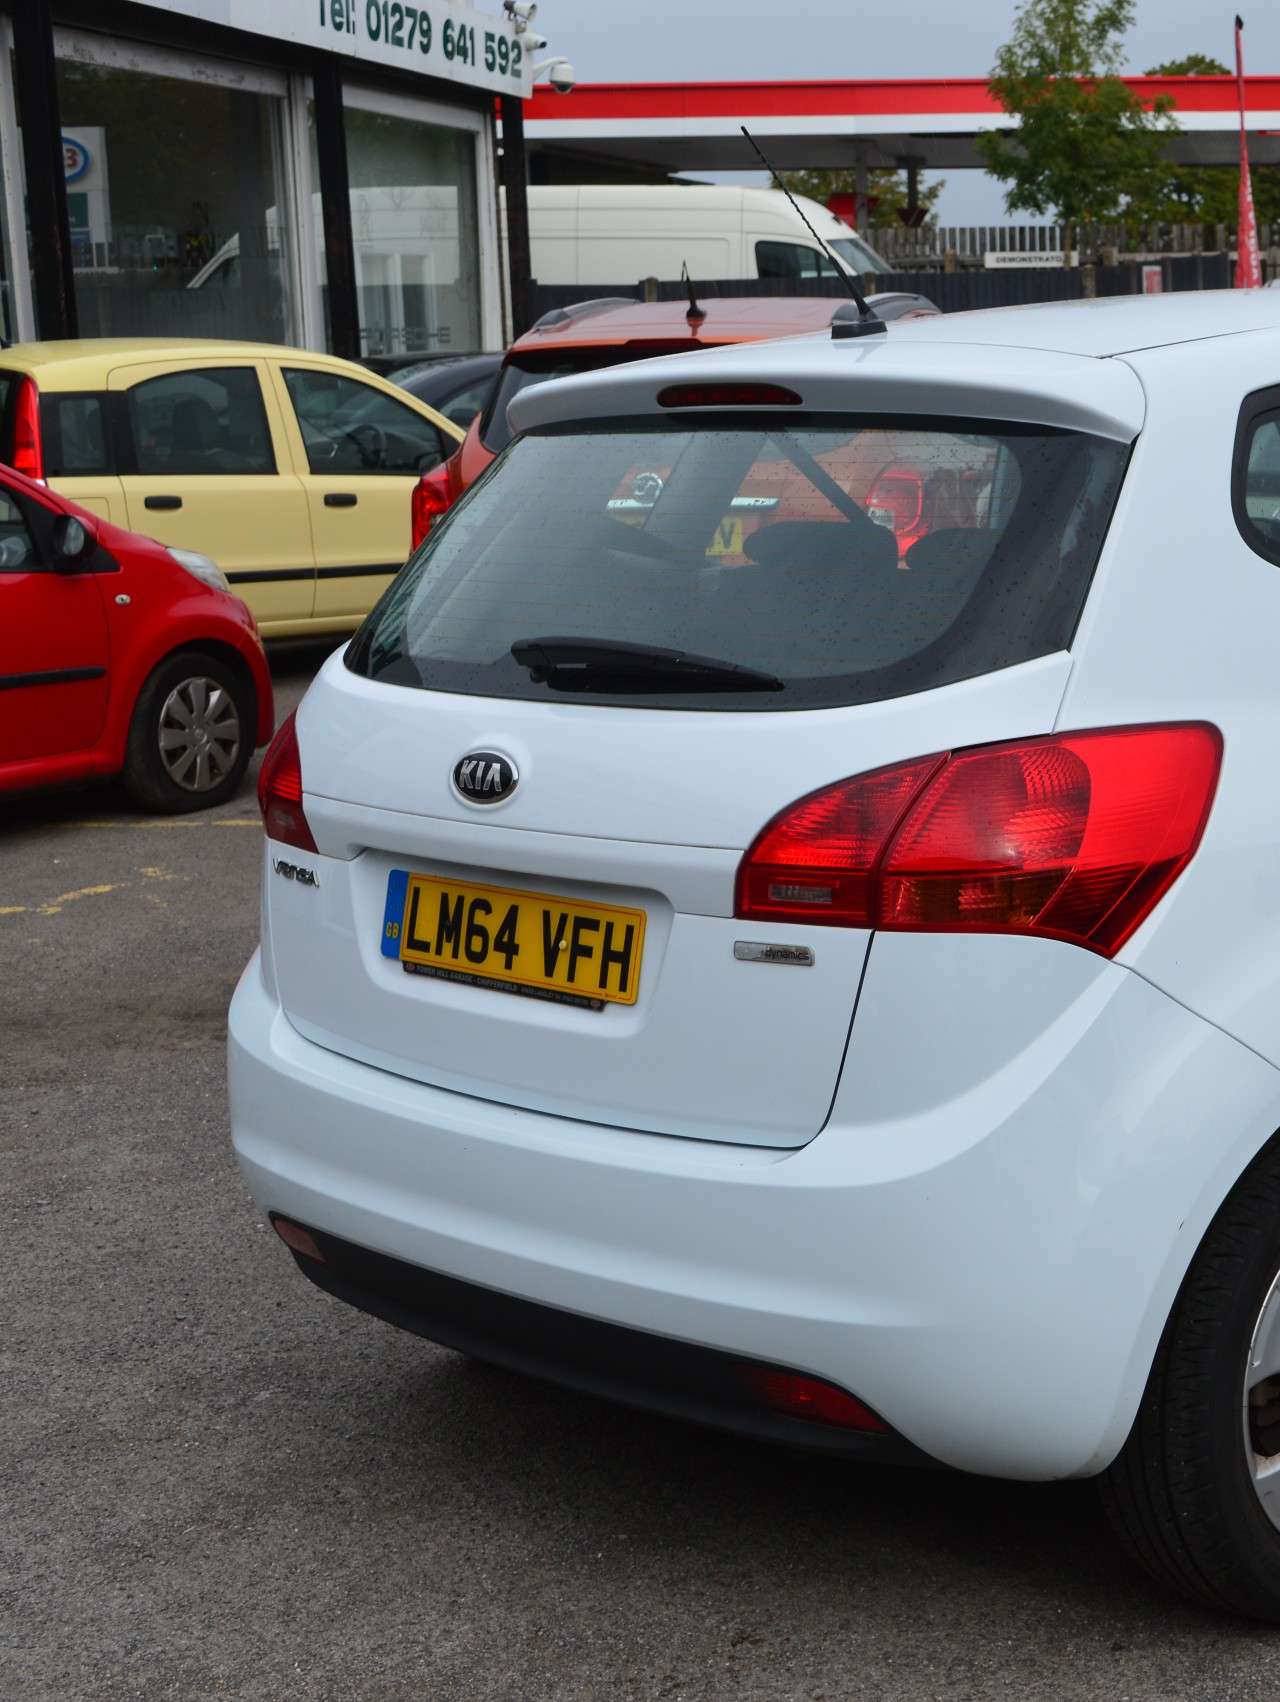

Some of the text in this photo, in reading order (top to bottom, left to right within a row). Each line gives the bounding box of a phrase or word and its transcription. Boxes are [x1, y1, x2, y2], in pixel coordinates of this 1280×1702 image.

[318, 0, 522, 78] Tel: 01279 641 592
[995, 255, 1067, 264] DEMONSTRATO
[459, 760, 502, 791] KIA
[385, 921, 399, 938] GB
[406, 886, 635, 993] LM64 VFH
